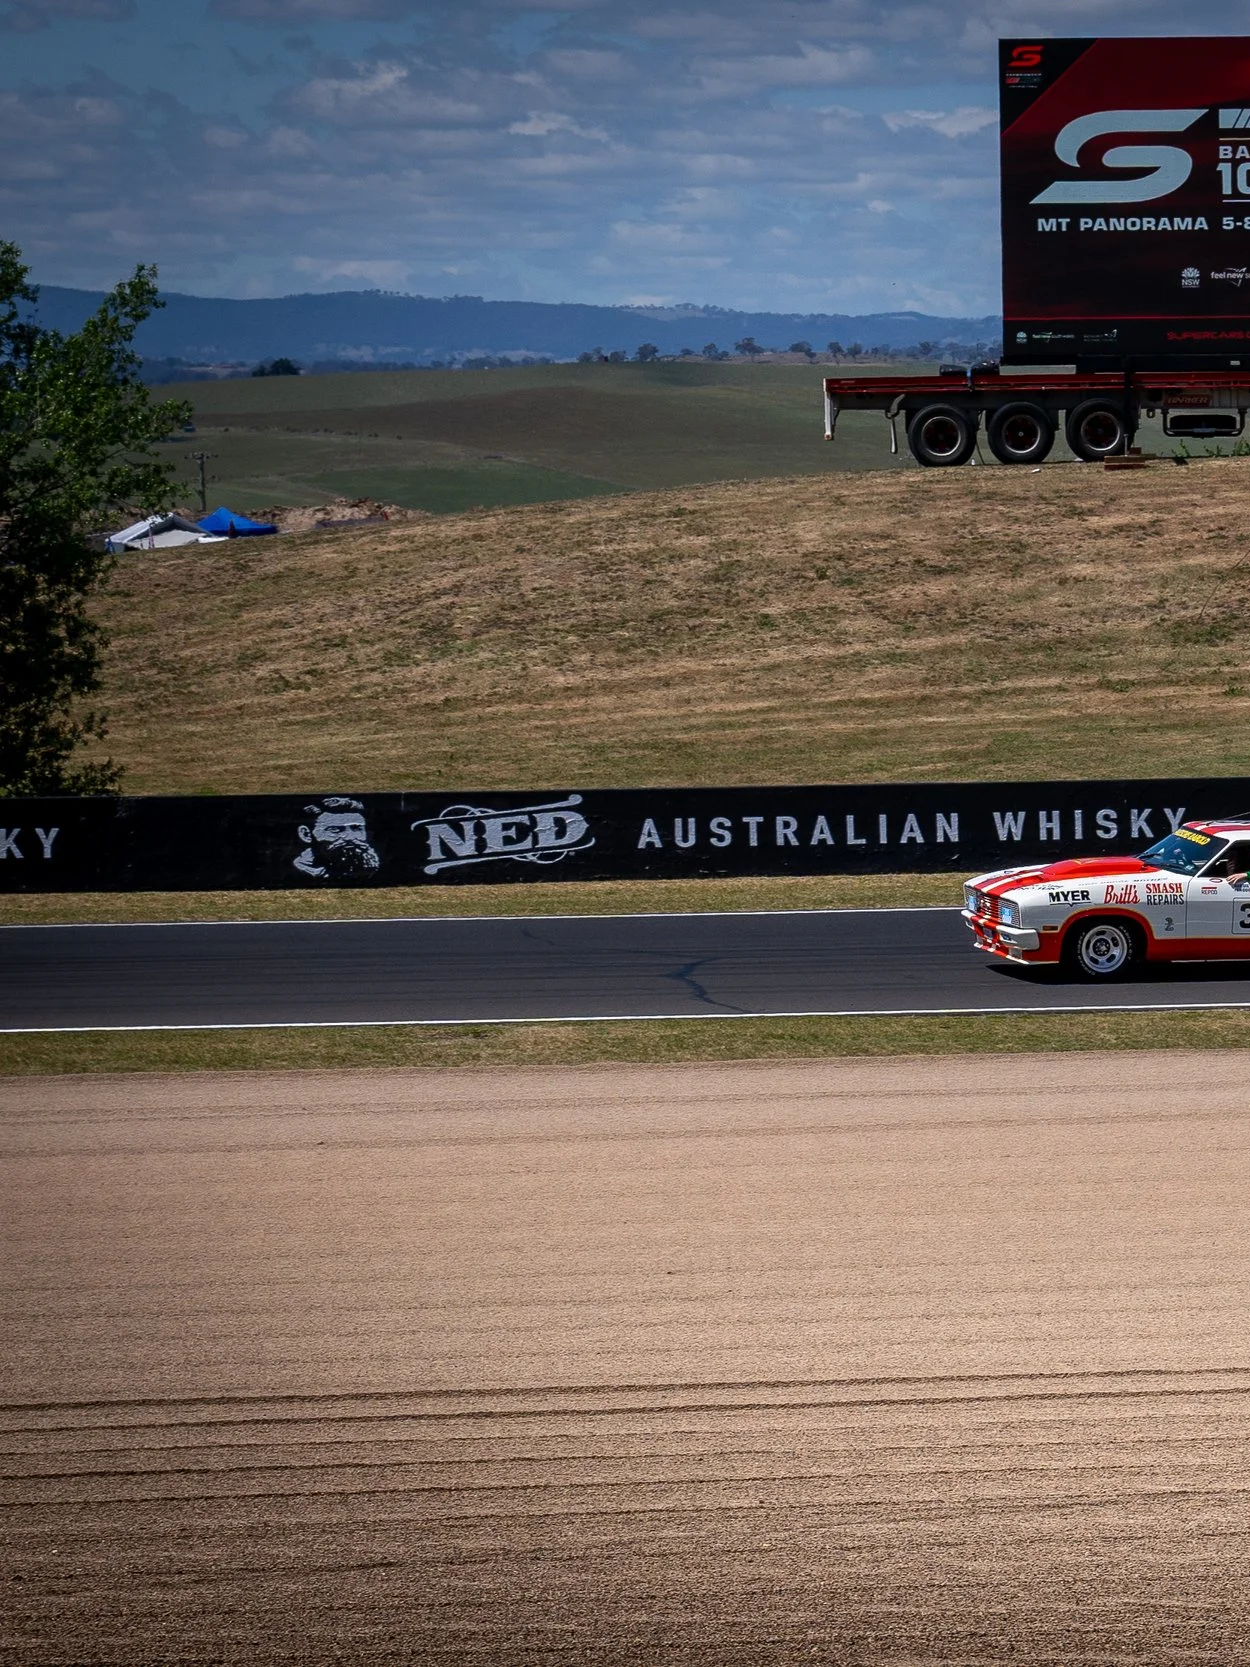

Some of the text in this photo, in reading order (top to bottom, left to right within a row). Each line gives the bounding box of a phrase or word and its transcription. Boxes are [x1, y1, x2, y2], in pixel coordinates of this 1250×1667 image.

[1037, 218, 1071, 232] MT
[1079, 217, 1209, 231] PANORAMA
[1210, 271, 1226, 279] feel
[637, 812, 960, 849] AUSTRALIAN
[993, 806, 1187, 842] WHISKY
[426, 809, 589, 861] NED
[1146, 883, 1183, 894] SMASH
[1048, 890, 1091, 903] MYER
[1146, 894, 1185, 906] REPAIRS
